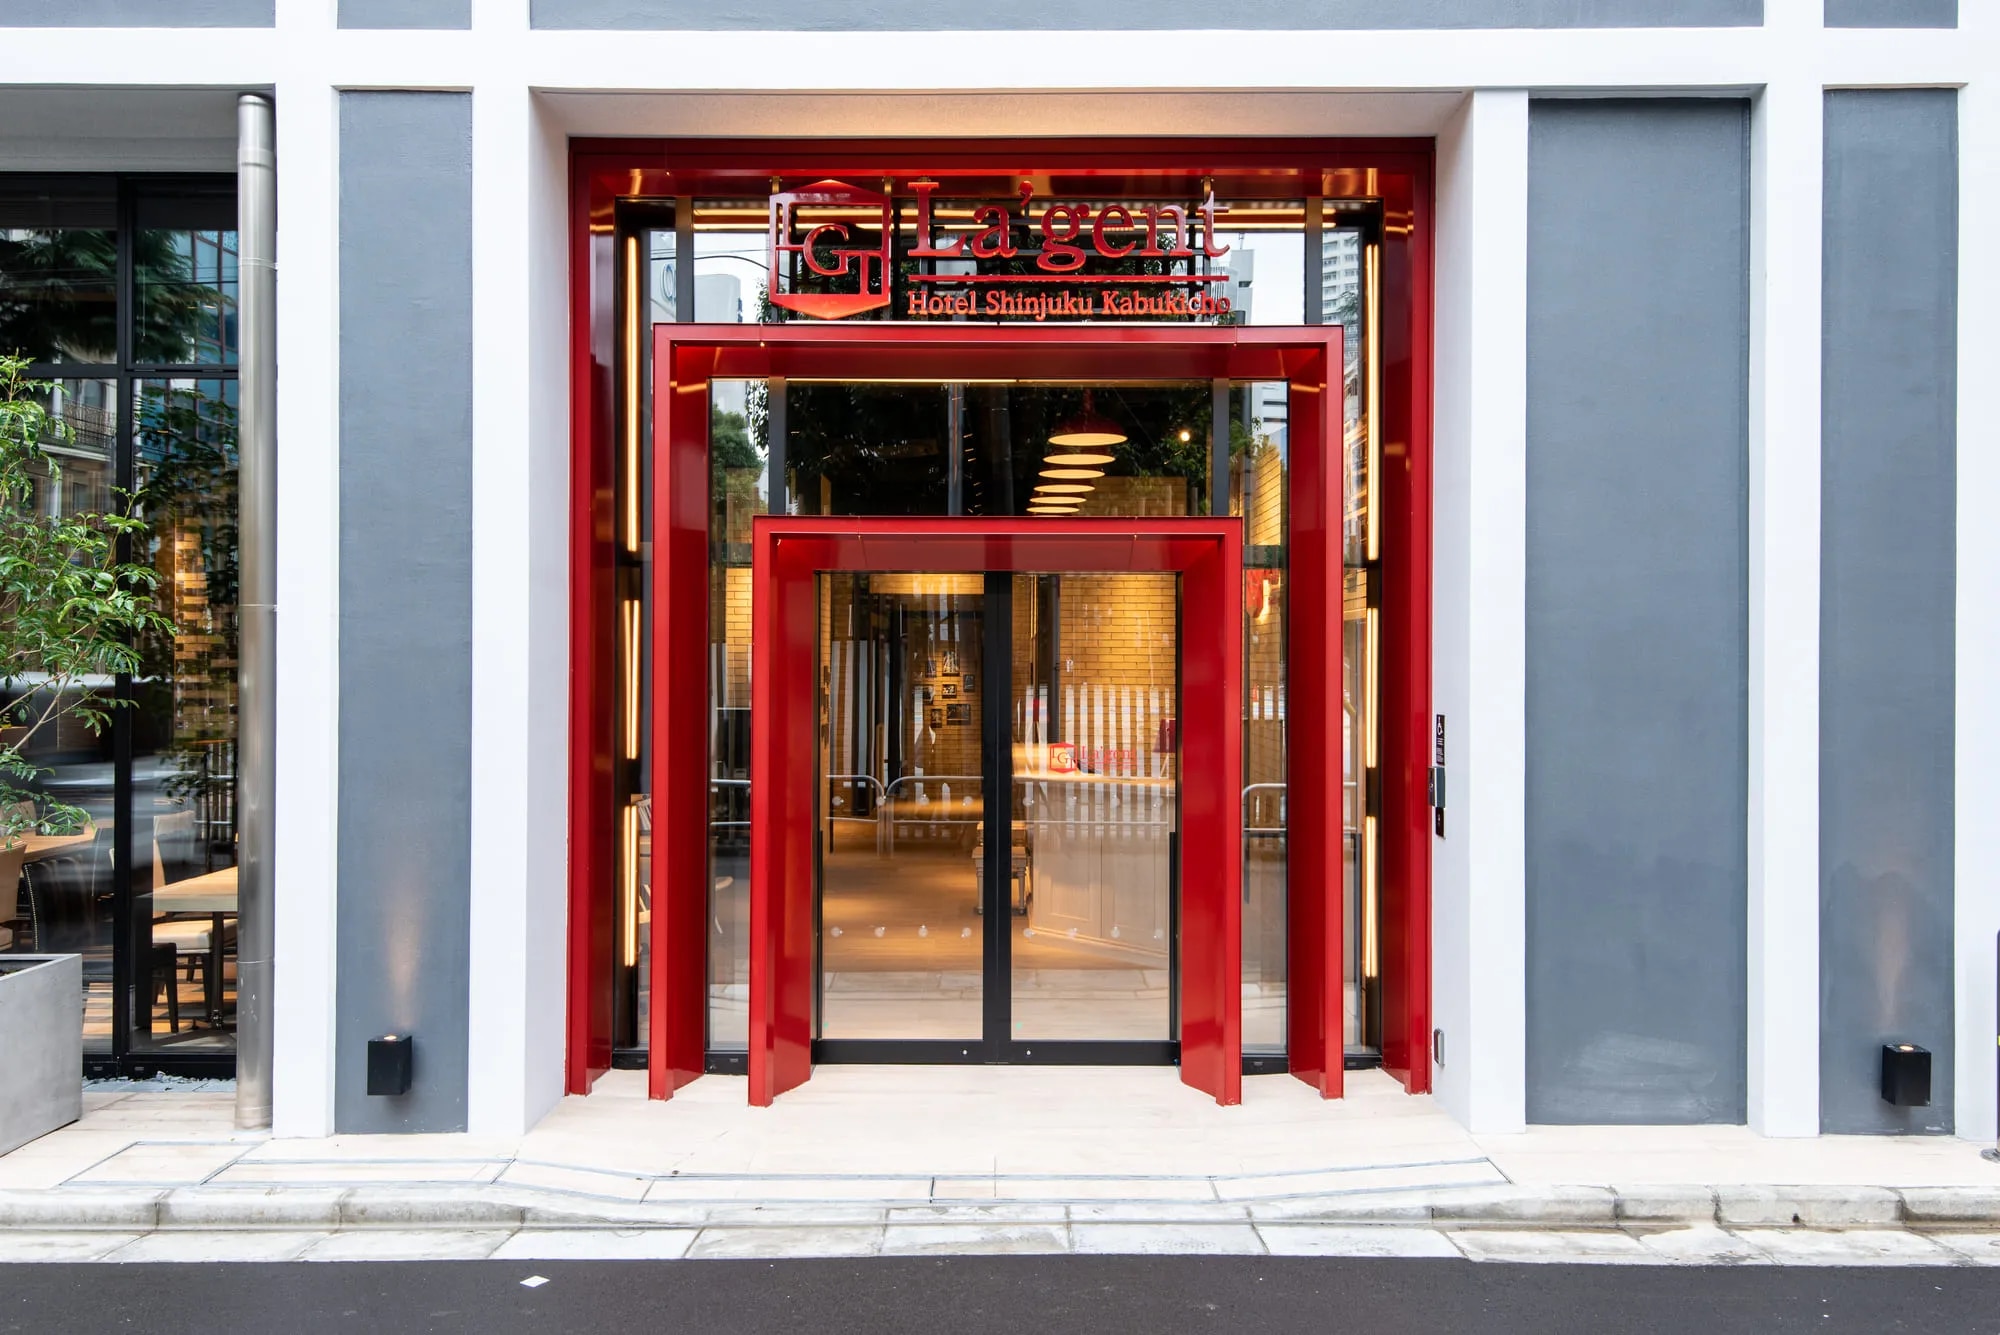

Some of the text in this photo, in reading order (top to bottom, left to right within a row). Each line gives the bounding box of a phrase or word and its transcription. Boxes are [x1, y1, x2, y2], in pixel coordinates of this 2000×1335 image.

[908, 181, 1231, 272] La'gent
[907, 289, 1231, 321] Hotel Shinjuku Kabukicho
